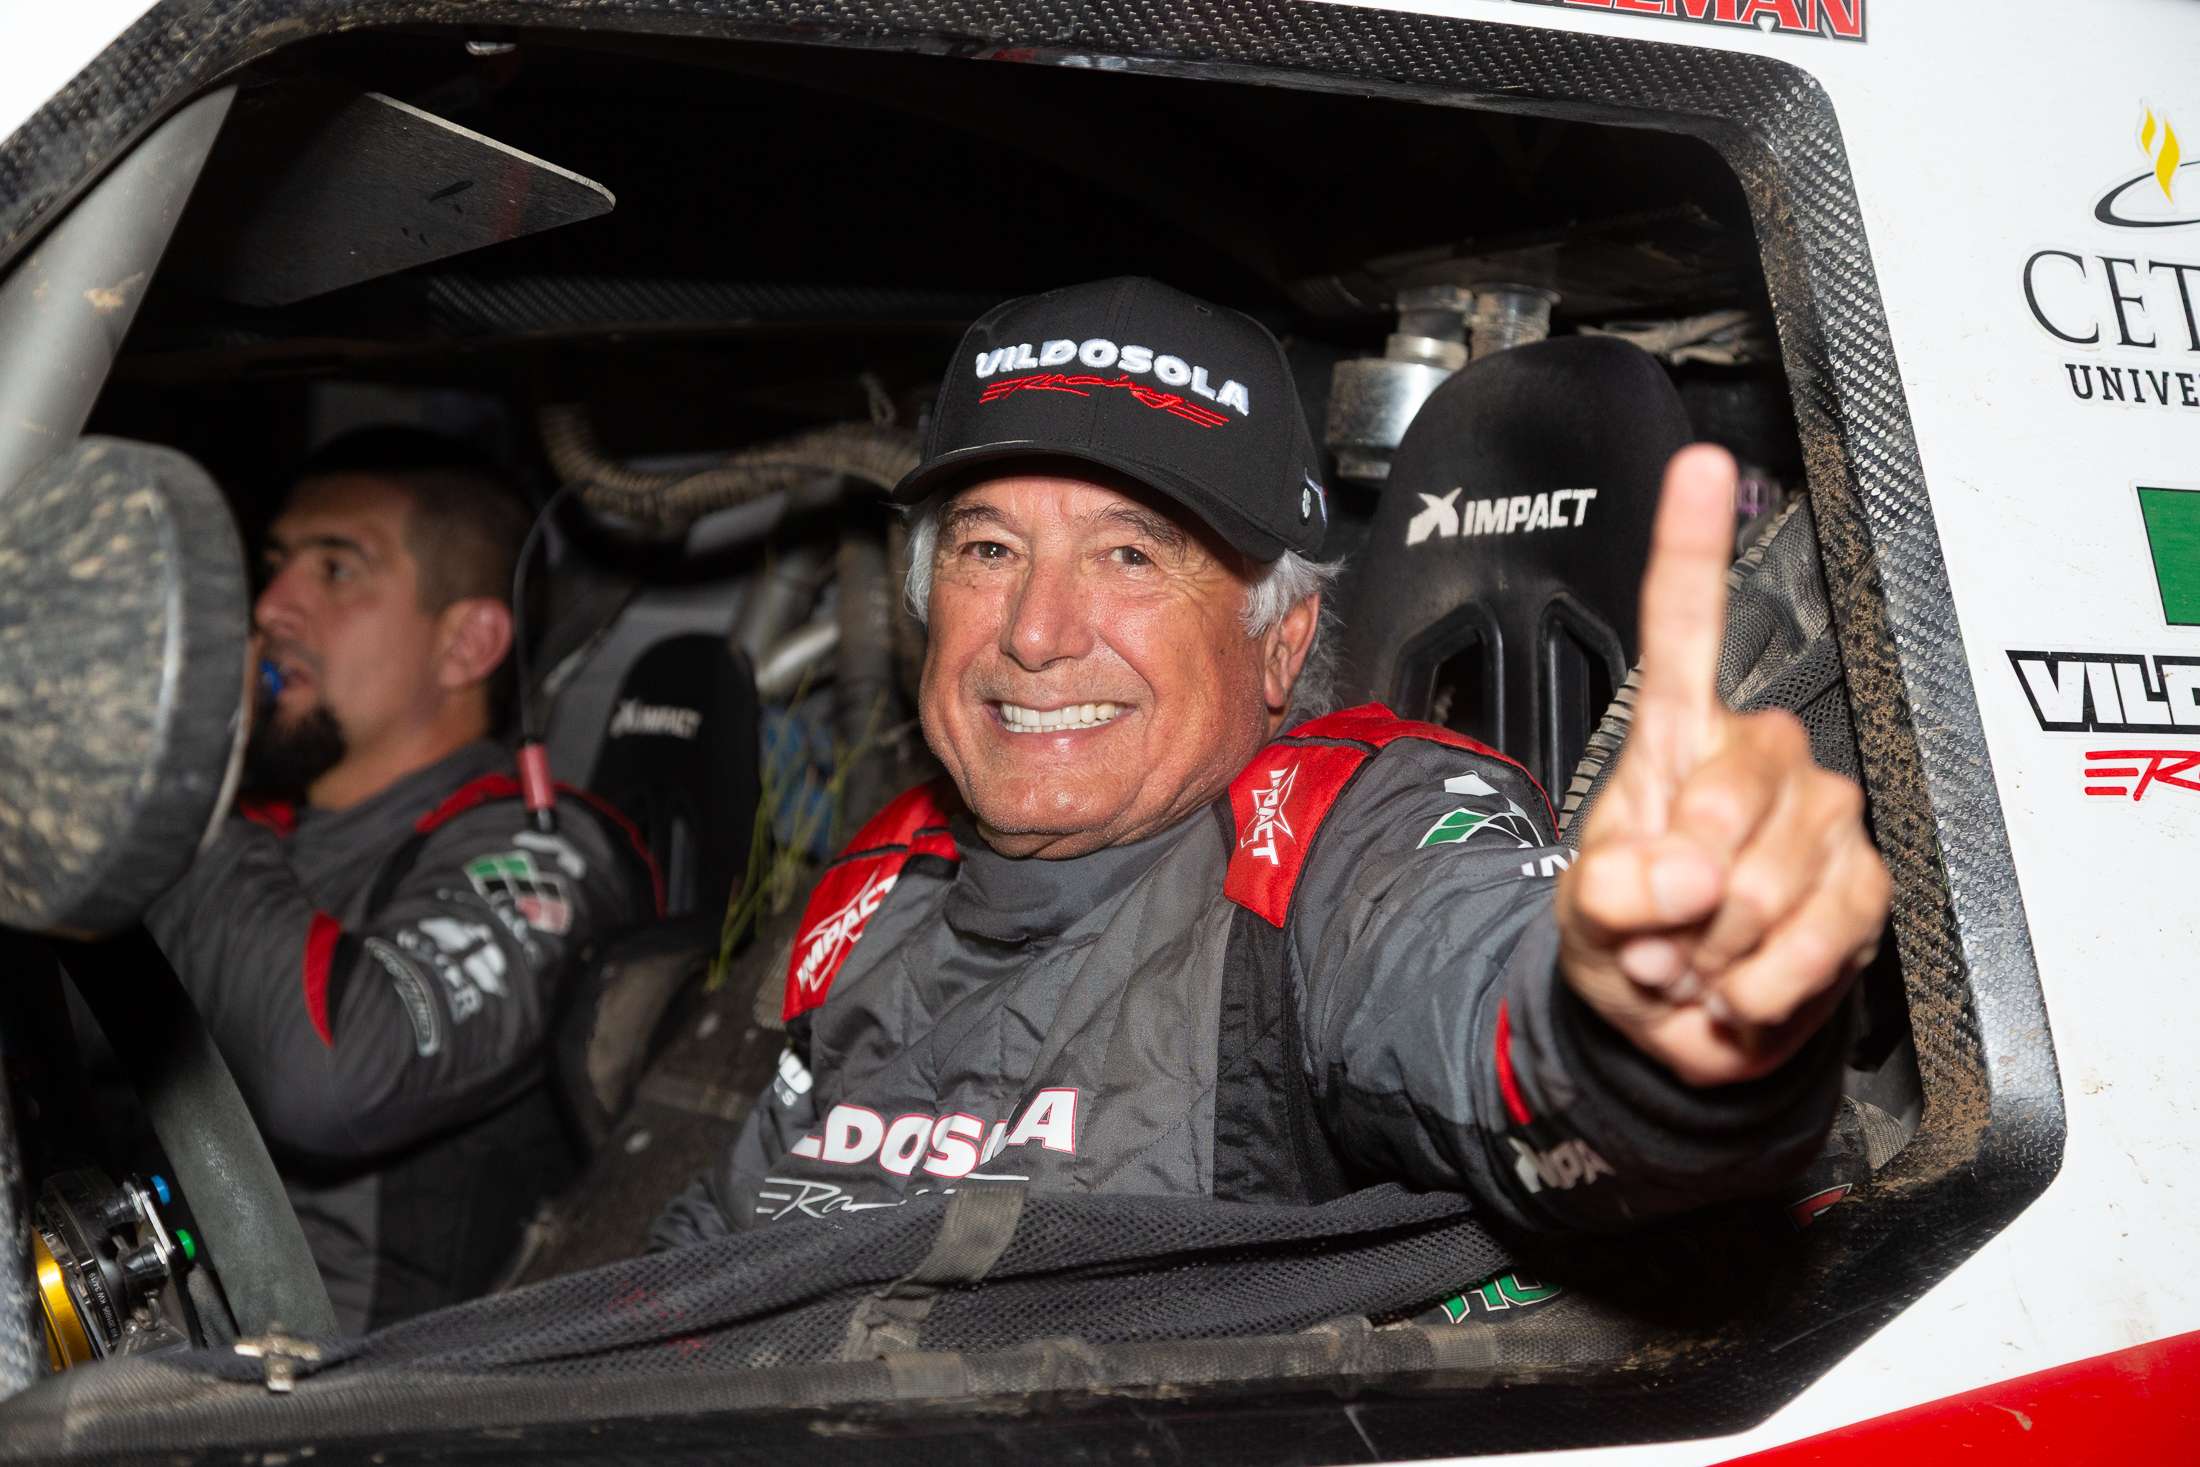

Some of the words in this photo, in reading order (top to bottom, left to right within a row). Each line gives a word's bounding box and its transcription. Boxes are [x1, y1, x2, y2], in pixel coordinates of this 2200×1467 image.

[2023, 250, 2200, 351] CET
[975, 338, 1250, 417] VILDOSOLA
[2065, 363, 2200, 407] UNIVE
[1463, 488, 1598, 537] IMPACT
